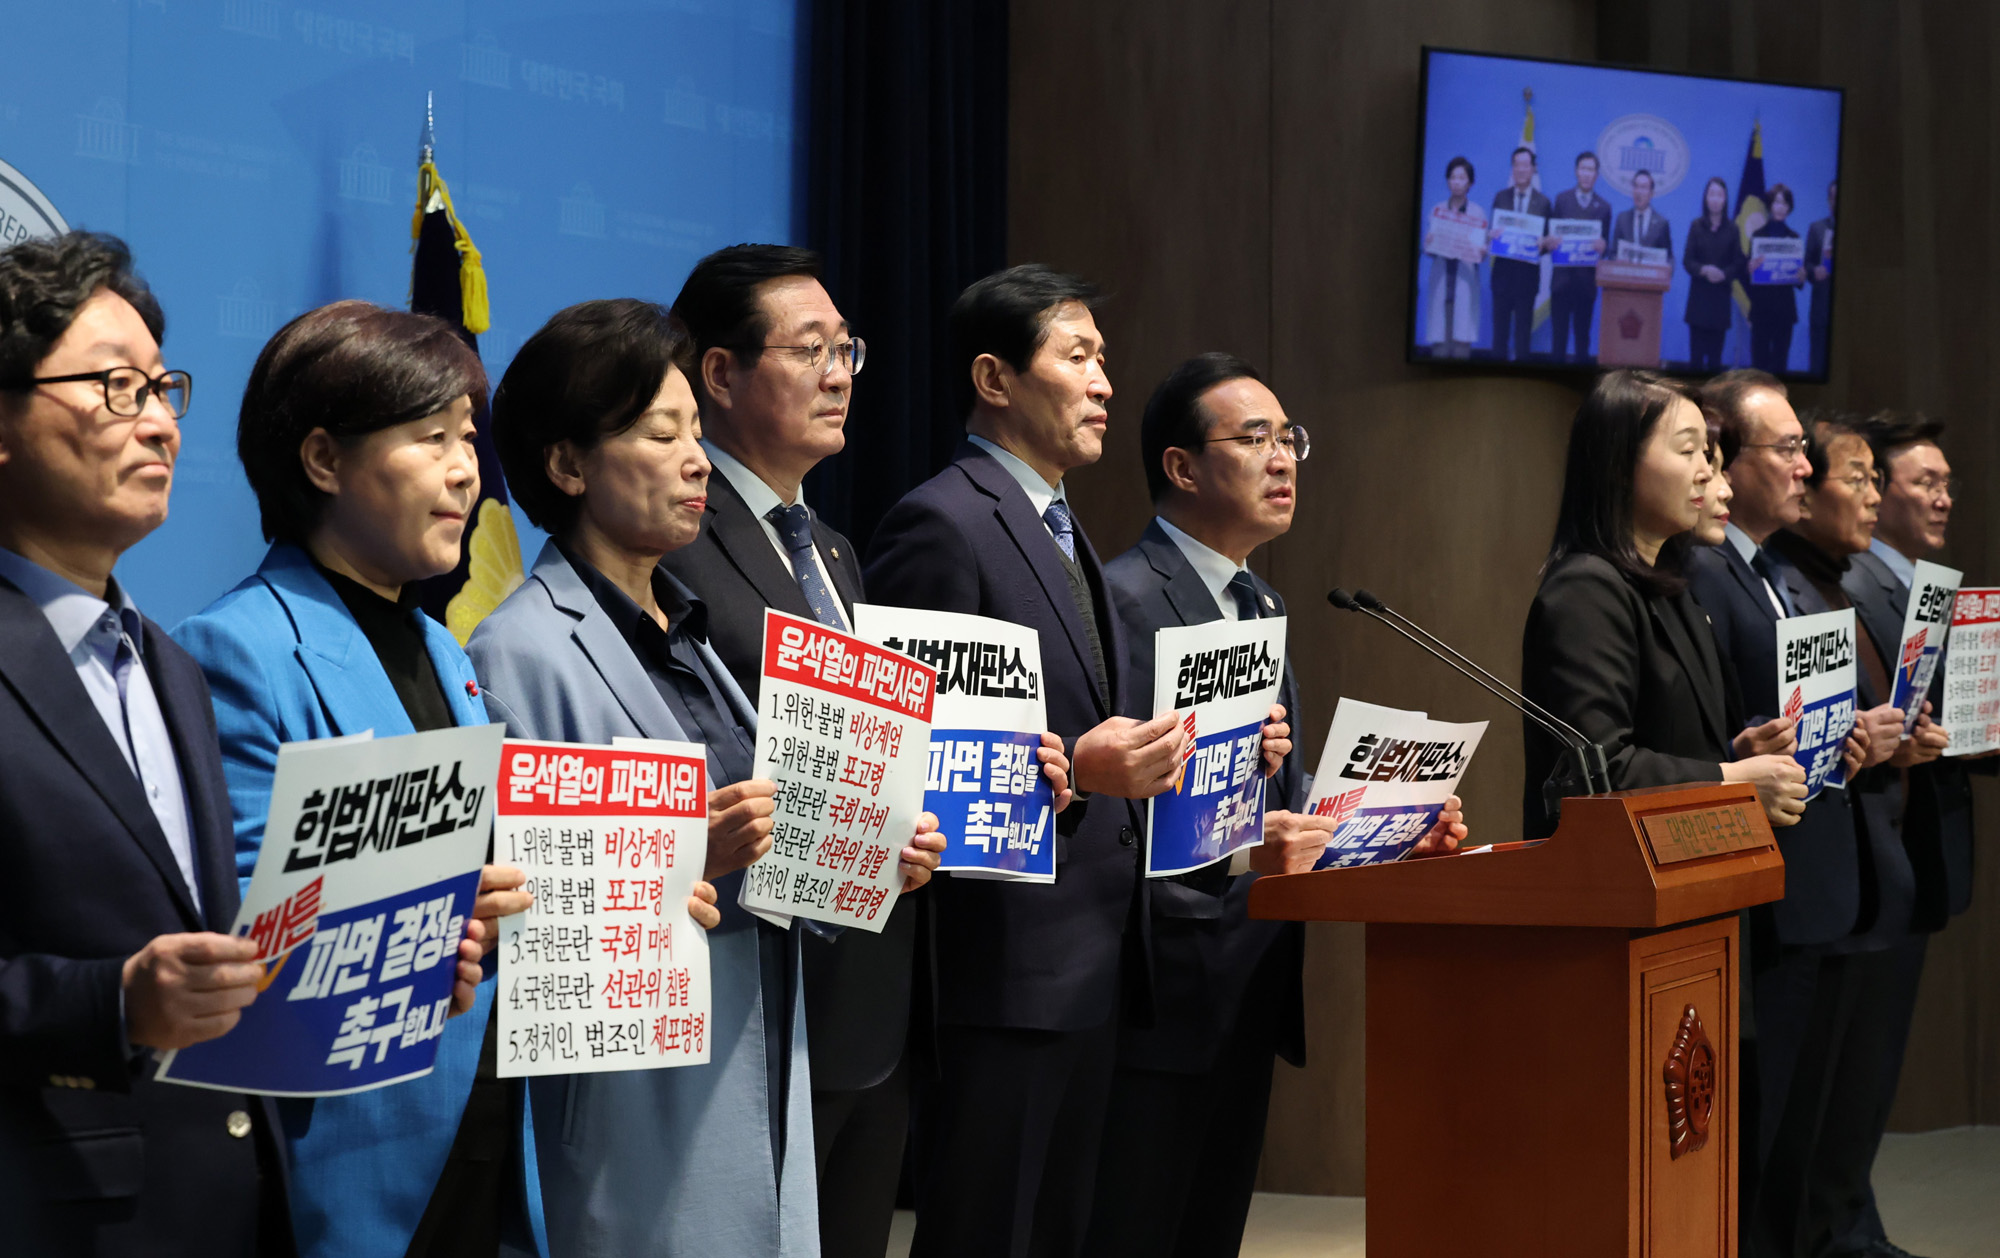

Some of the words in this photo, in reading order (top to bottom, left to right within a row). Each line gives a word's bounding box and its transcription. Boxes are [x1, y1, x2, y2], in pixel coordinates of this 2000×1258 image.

[777, 625, 859, 688] 윤석열의
[857, 652, 930, 714] 파면사유!
[1174, 639, 1280, 710] 헌법재판소의
[849, 711, 903, 758] 비상계엄
[1182, 710, 1196, 762] 른
[1797, 705, 1828, 752] 파면
[509, 752, 604, 805] 윤석열의
[607, 758, 698, 812] 파면사유!
[839, 755, 886, 796] 포고령
[924, 739, 985, 792] 파면
[989, 742, 1040, 795] 결정을
[1190, 739, 1233, 797] 파면
[1339, 733, 1469, 783] 헌법재판소의
[282, 760, 486, 874] 헌법재판소의
[829, 794, 861, 832] 국회
[858, 802, 890, 839] 마비
[964, 799, 1050, 855] 촉구합니다!
[1325, 814, 1390, 849] 파면
[1365, 811, 1430, 848] 결정을
[1665, 807, 1757, 857] 대한민국국회
[604, 827, 676, 869] 비상계엄
[769, 821, 815, 861] 헌문란
[816, 833, 863, 874] 선관위
[858, 844, 890, 879] 침탈
[602, 875, 665, 916] 포고령
[792, 872, 834, 909] 법조인
[830, 880, 889, 921] 체포명령
[286, 913, 387, 1002] 파면
[378, 893, 465, 984] 결정을
[511, 925, 593, 965] 3.국헌문란
[599, 923, 643, 963] 국회
[648, 923, 673, 963] 마비
[509, 972, 595, 1012] 4.국헌문란
[601, 968, 662, 1010] 선관위
[665, 967, 691, 1008] 침탈
[509, 1021, 579, 1063] 5.정치인,
[585, 1018, 646, 1059] 법조인
[650, 1012, 705, 1056] 체포명령
